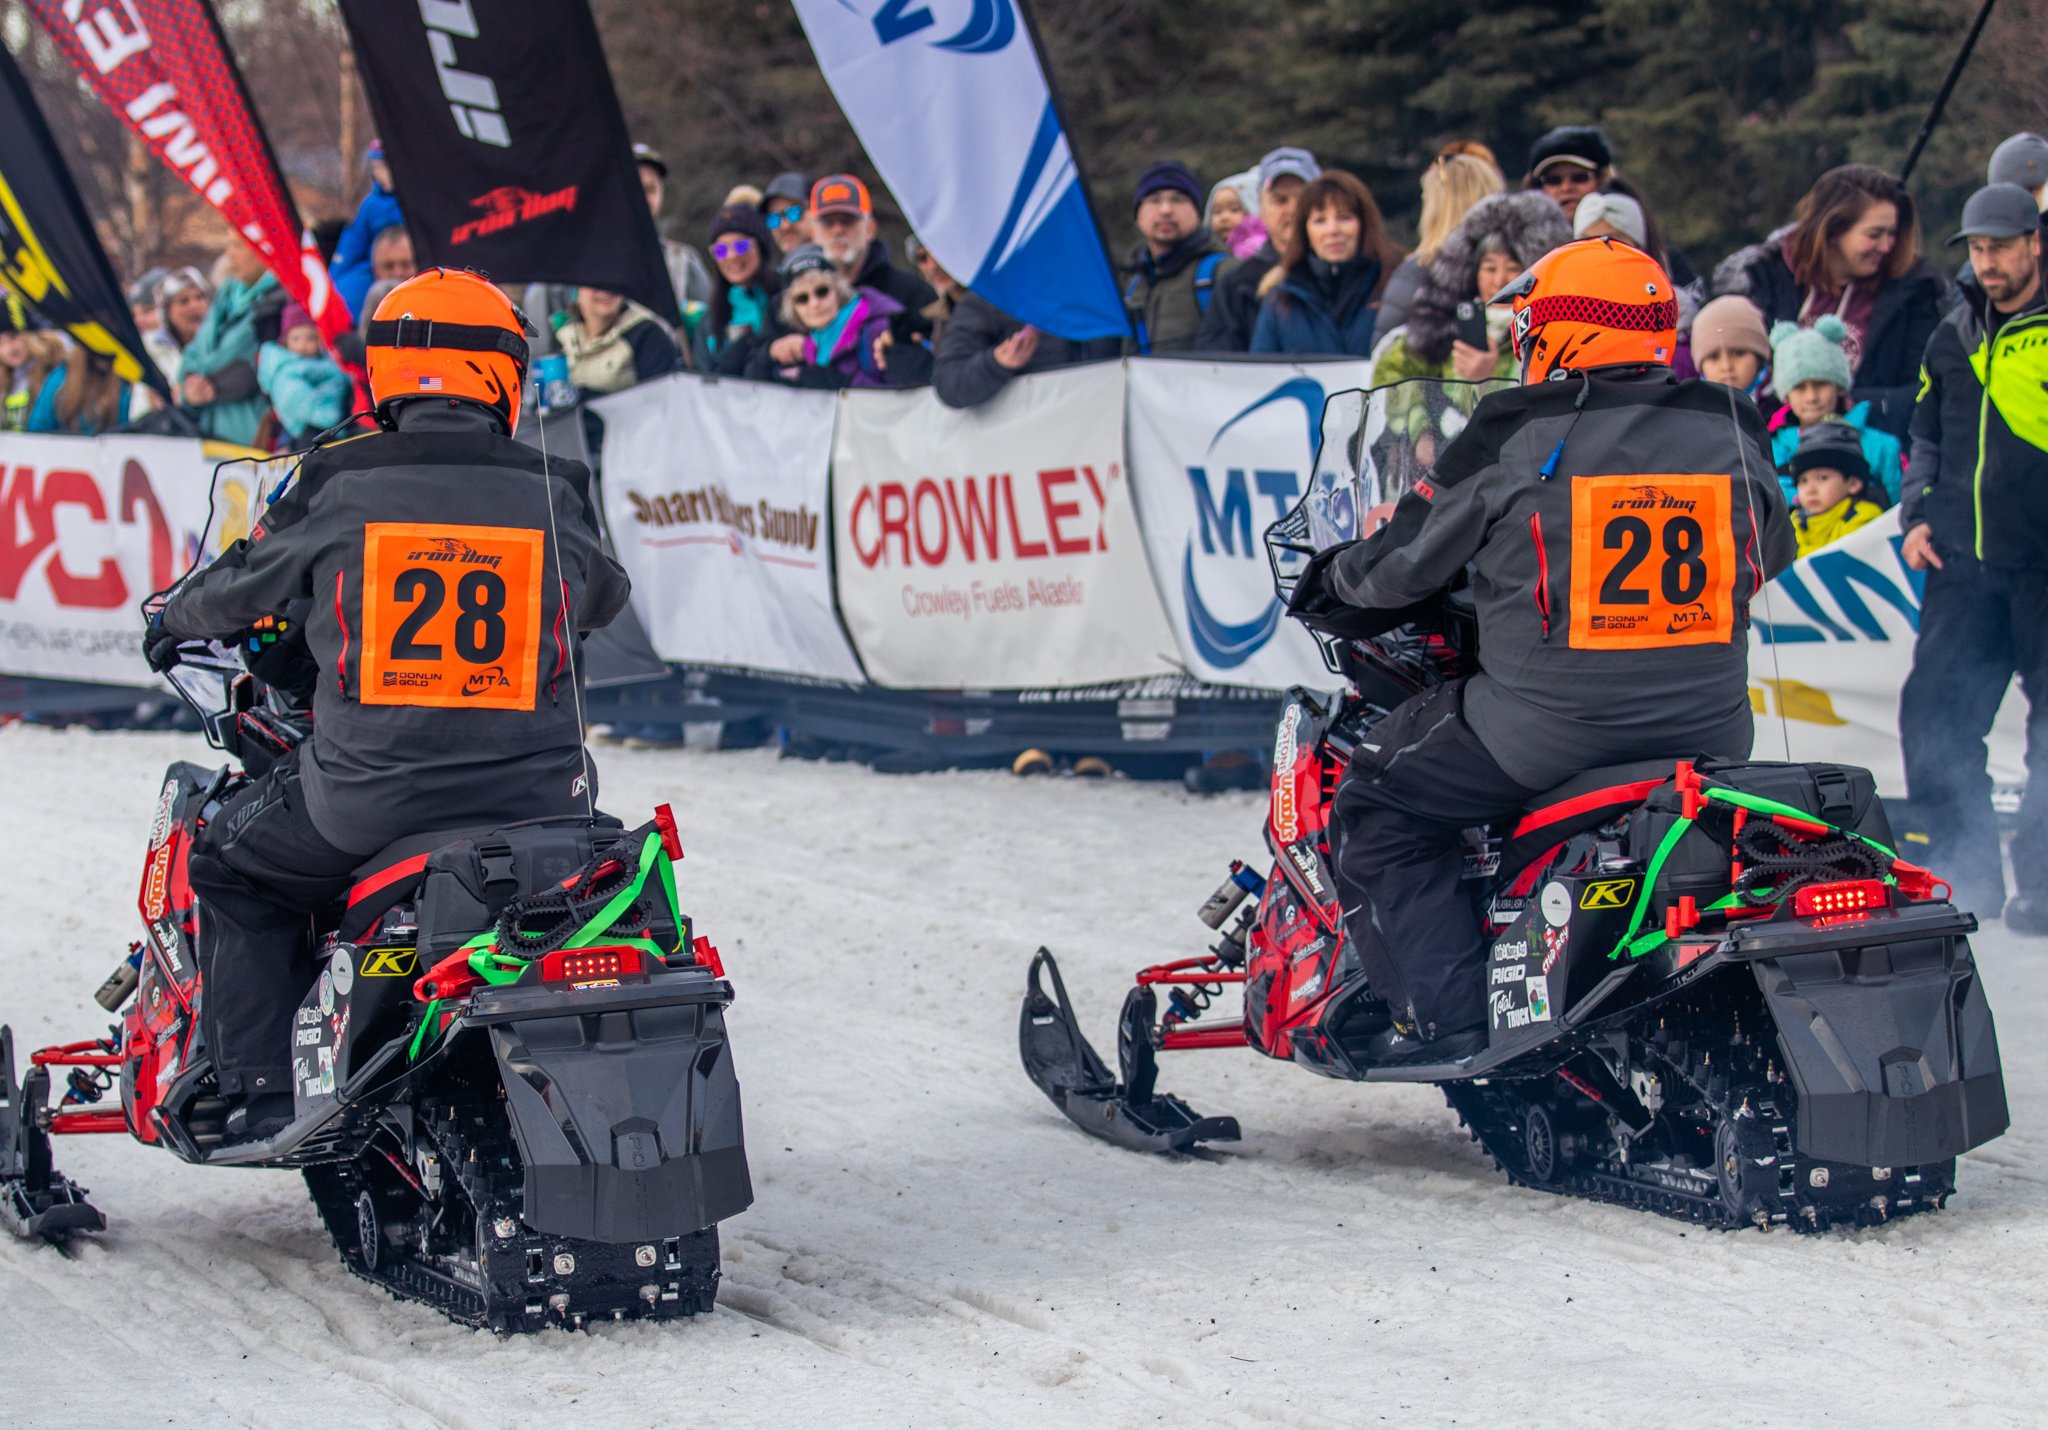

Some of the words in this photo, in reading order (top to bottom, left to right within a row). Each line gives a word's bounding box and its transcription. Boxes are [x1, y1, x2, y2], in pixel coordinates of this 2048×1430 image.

[850, 465, 1109, 570] CROWLEY
[1599, 515, 1707, 606] 28
[390, 567, 506, 665] 28
[1607, 615, 1649, 623] DONLIN
[1673, 611, 1713, 623] MTA
[1607, 622, 1636, 630] GOLD
[398, 671, 442, 681] DONLIN
[469, 674, 511, 687] MTA
[398, 679, 429, 688] GOLD
[1279, 704, 1297, 773] CAPSTONE
[152, 780, 175, 850] CAPSTONE
[1583, 882, 1631, 907] K
[364, 951, 415, 973] K
[1491, 964, 1526, 985] RIGID
[1506, 1006, 1531, 1029] TRUCK
[296, 1027, 322, 1047] RIGID
